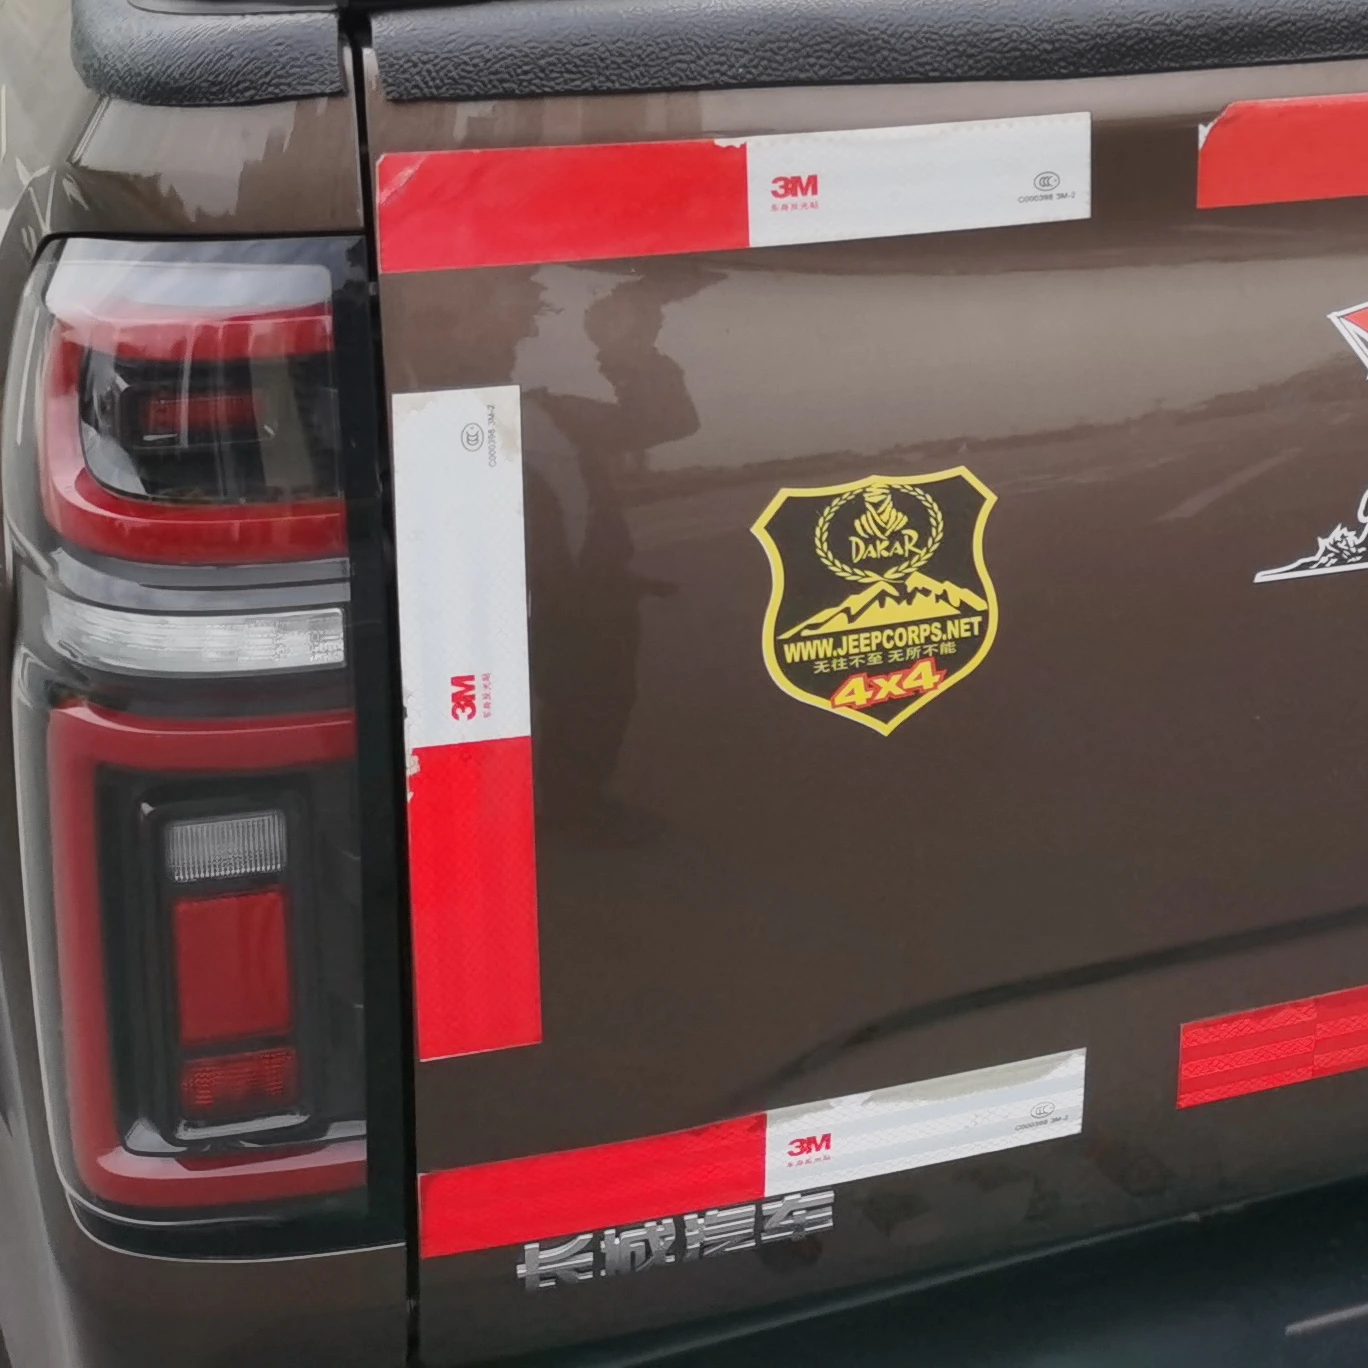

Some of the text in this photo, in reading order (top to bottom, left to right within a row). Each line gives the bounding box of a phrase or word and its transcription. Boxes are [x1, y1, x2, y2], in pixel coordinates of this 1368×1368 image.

[771, 174, 818, 199] 3M
[849, 529, 925, 563] DAKAR
[784, 616, 982, 663] WWW.JEEPCORPS.NET
[813, 642, 957, 674] 无往不至 无所不能
[451, 675, 476, 720] 3M
[787, 1133, 831, 1157] 3M
[517, 1191, 834, 1291] 长城汽车
